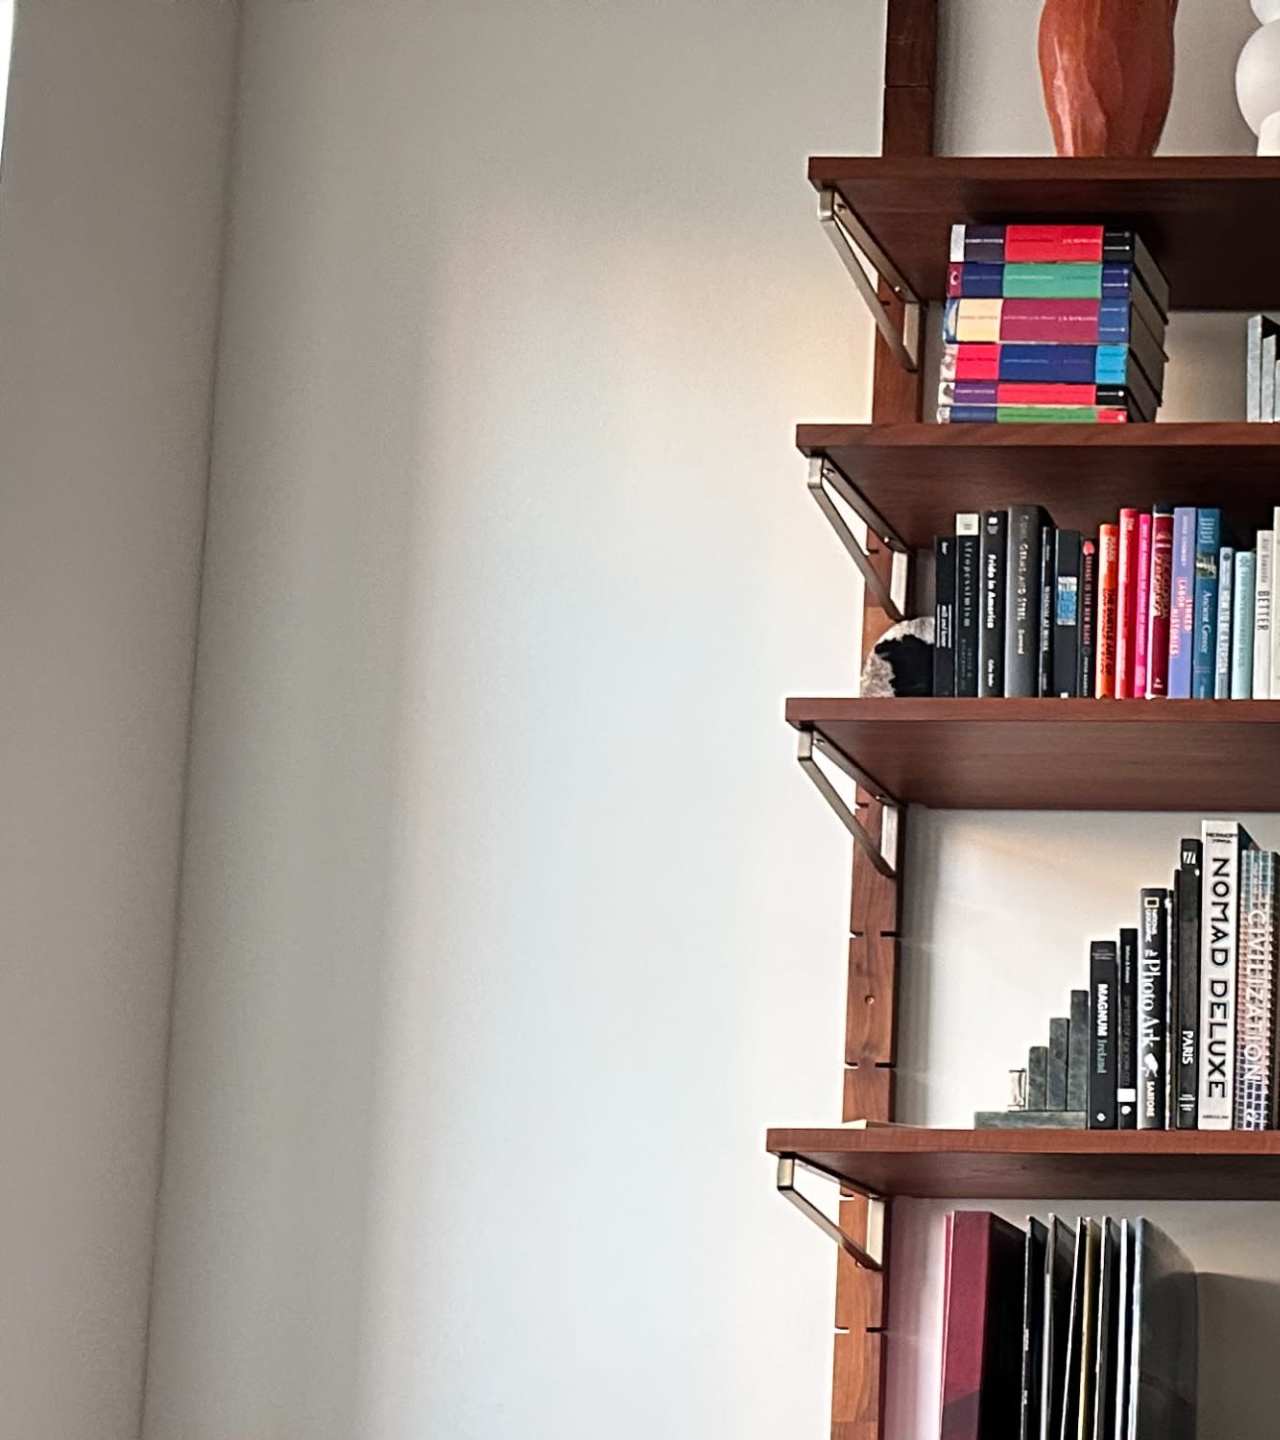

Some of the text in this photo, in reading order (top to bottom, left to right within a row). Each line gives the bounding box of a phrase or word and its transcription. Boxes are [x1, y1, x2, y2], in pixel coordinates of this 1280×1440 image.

[1257, 590, 1270, 631] BETTER
[1210, 858, 1230, 967] NOMAD
[1097, 984, 1108, 1036] MAGNUM
[1141, 958, 1161, 1048] Photo Ark
[1208, 980, 1228, 1098] DELUXE
[1245, 910, 1268, 1081] CIVILIZATION
[1182, 1031, 1194, 1065] PARIS
